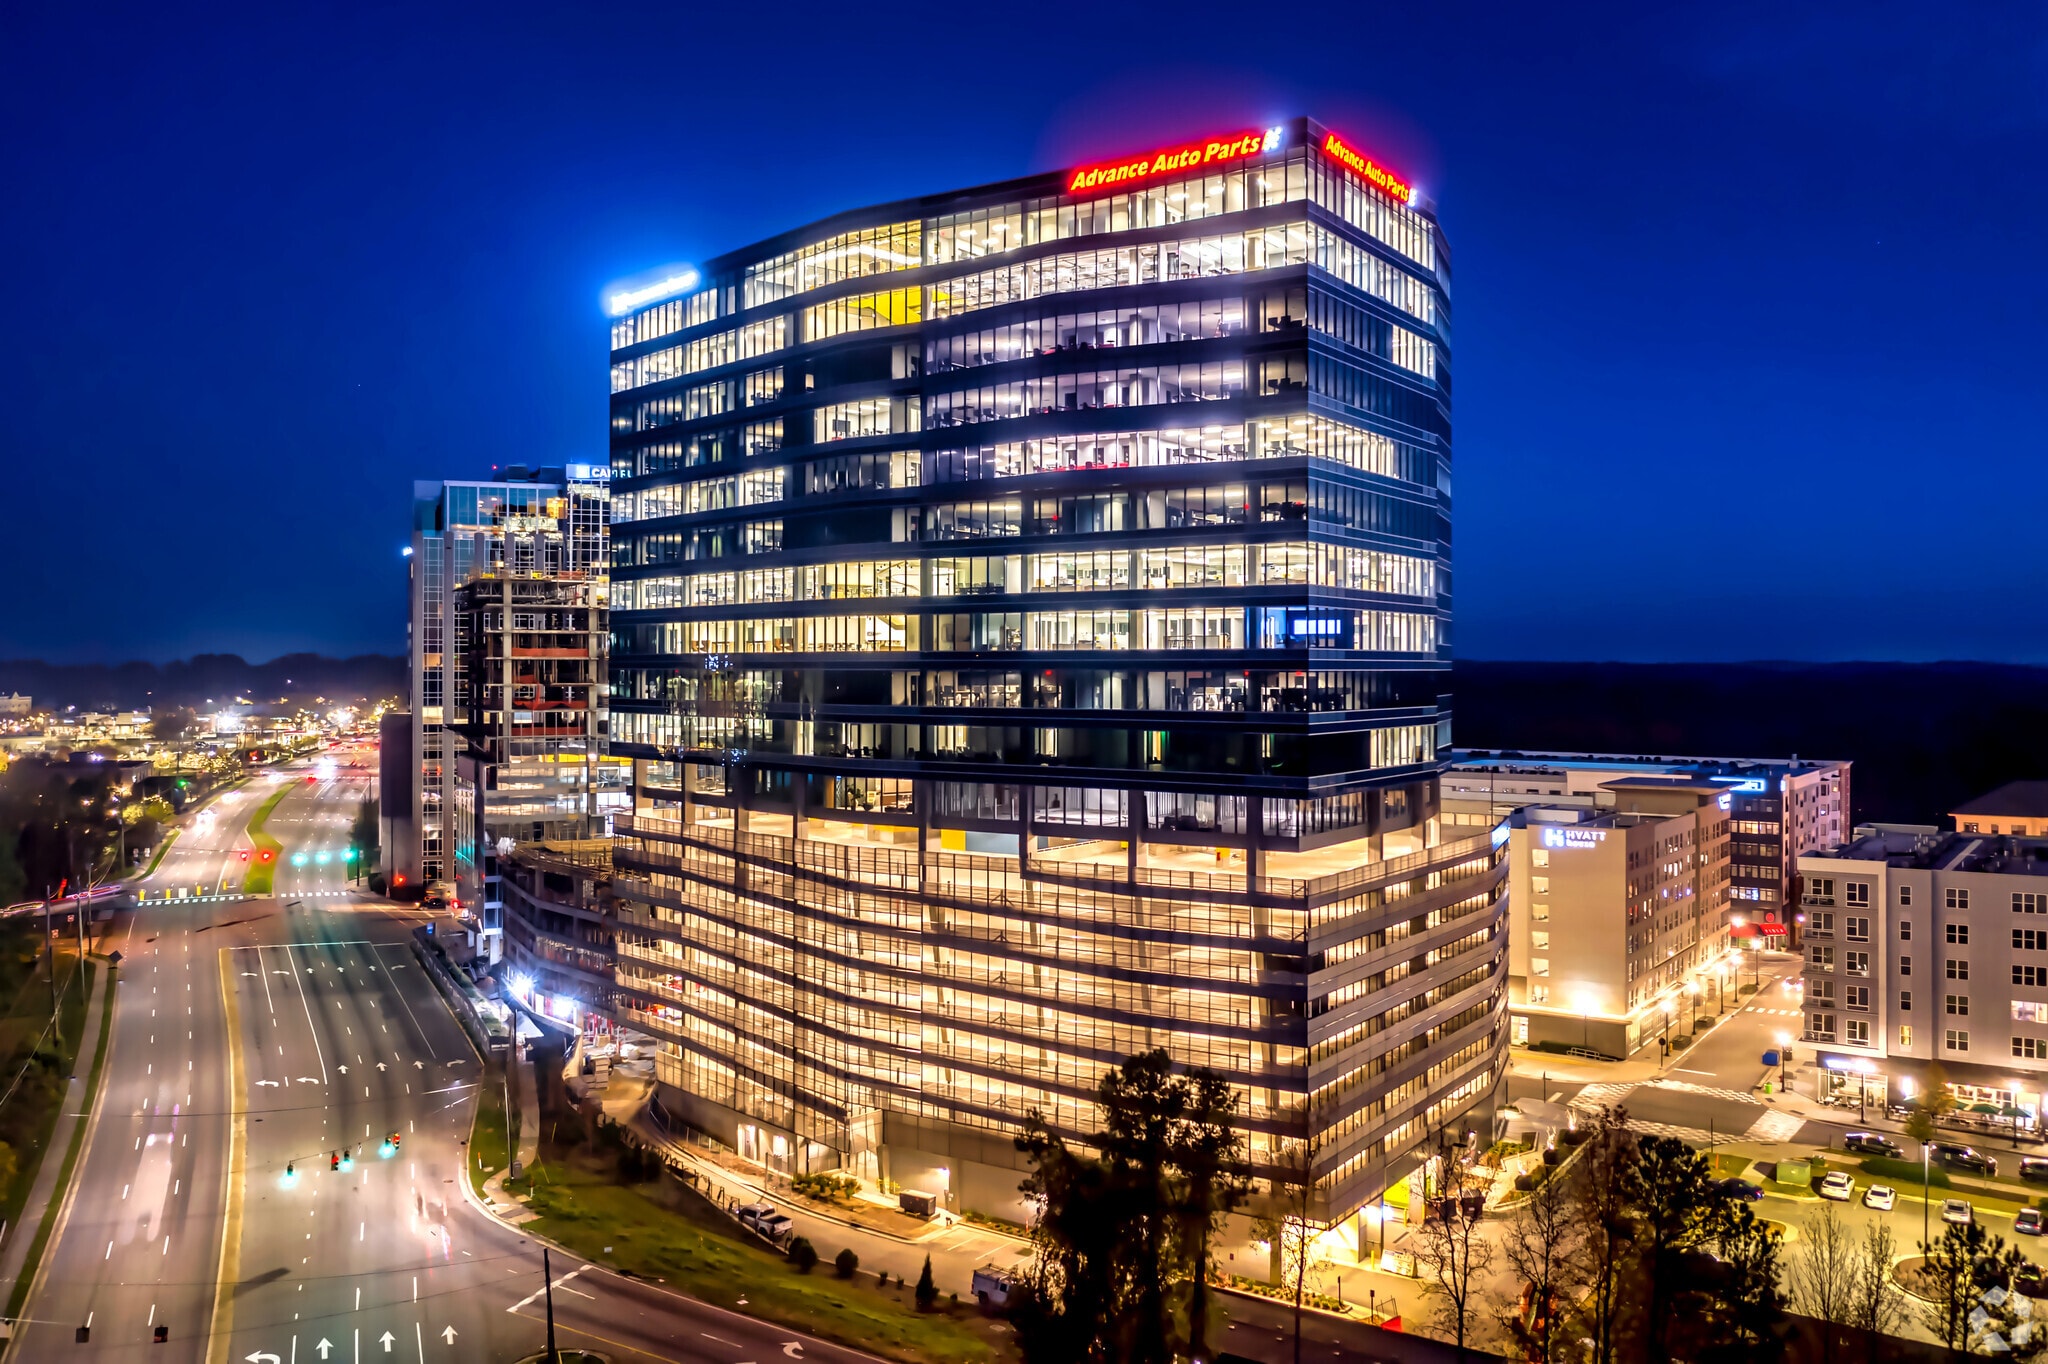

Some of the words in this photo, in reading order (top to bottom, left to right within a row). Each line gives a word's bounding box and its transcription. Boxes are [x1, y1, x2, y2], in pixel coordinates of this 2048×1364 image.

[1071, 161, 1148, 190] Advance
[1151, 149, 1201, 174] Auto
[1203, 136, 1261, 163] Parts
[1326, 135, 1364, 172] Advance
[1365, 161, 1386, 186] Auto
[1387, 174, 1409, 201] Parts
[1566, 830, 1606, 841] HYATT
